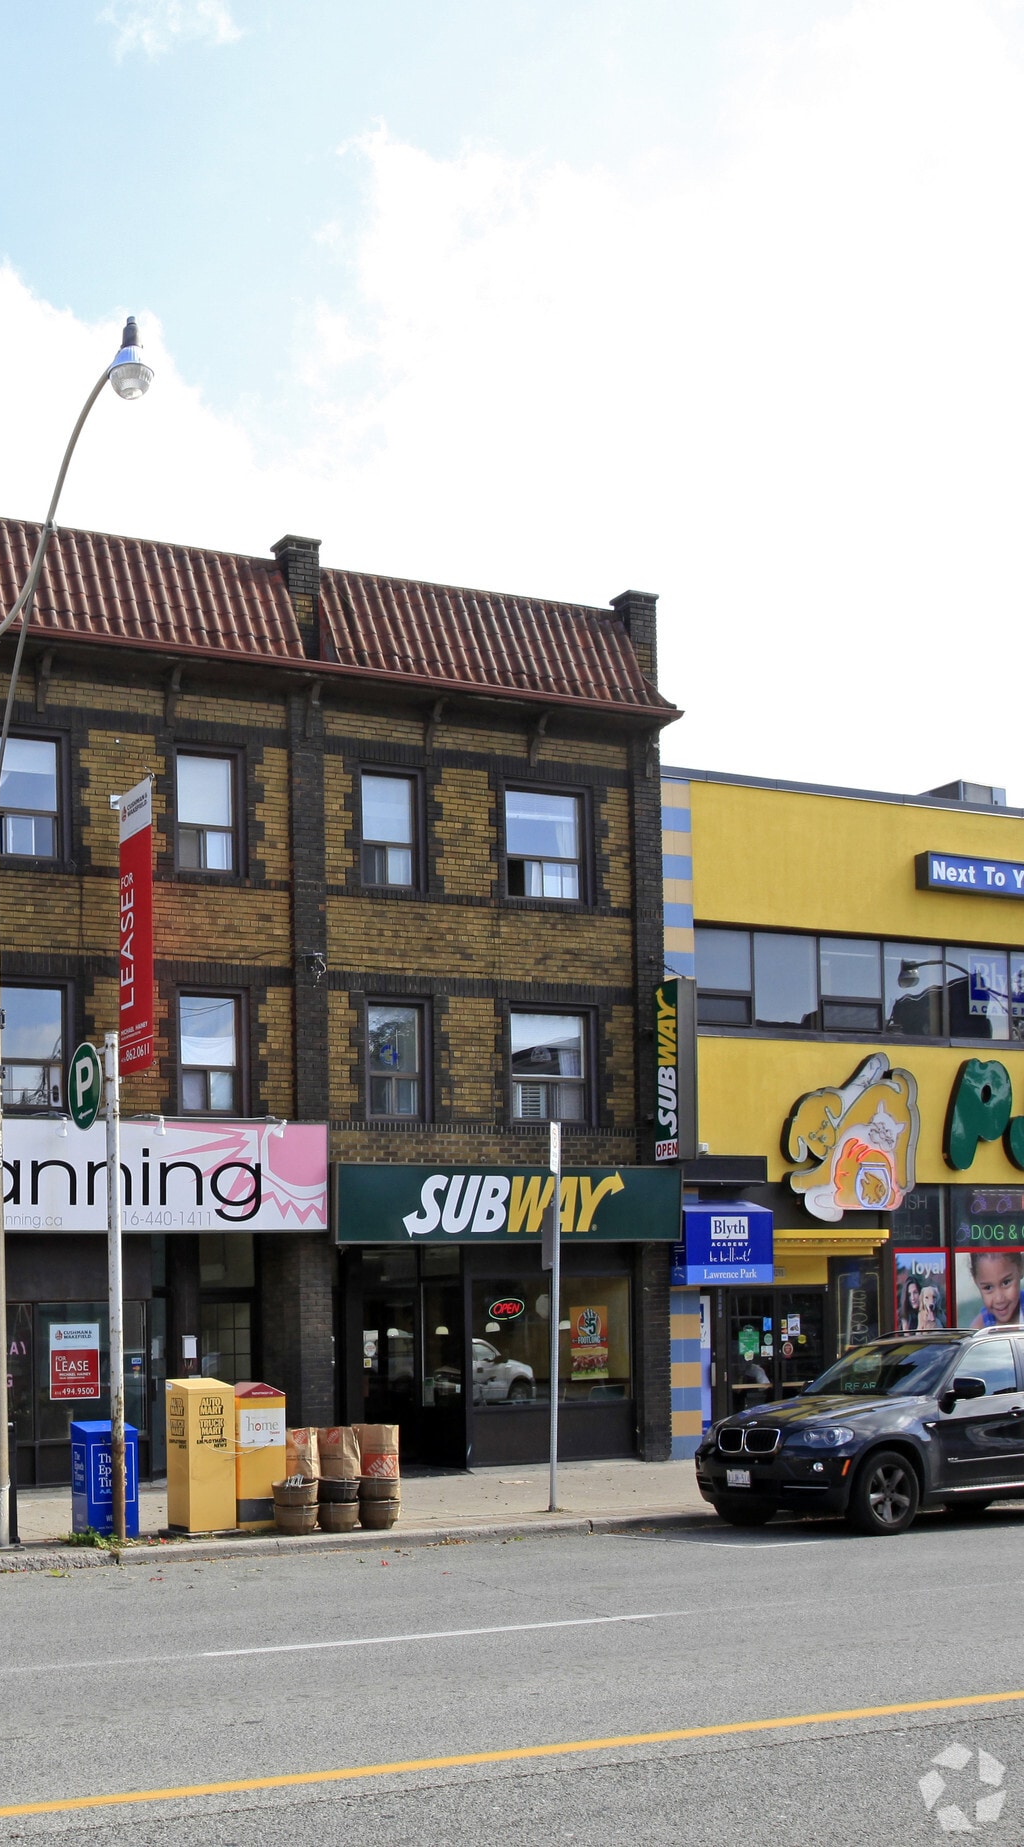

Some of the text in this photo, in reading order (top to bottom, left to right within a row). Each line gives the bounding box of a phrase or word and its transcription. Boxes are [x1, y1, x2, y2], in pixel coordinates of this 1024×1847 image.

[121, 872, 134, 889] FOR
[932, 860, 976, 884] Next
[983, 866, 1006, 887] To
[120, 888, 134, 1011] LEASE
[655, 987, 677, 1137] SUBWAY
[76, 1056, 94, 1108] P
[656, 1142, 677, 1157] OPEN
[402, 1171, 625, 1238] SUBWAY
[122, 1210, 213, 1227] 16-440-1411
[713, 1219, 746, 1239] Blyth
[971, 1224, 1018, 1241] DOG &
[703, 1268, 758, 1280] Lawrence Park
[912, 1258, 945, 1279] loyal
[493, 1302, 521, 1316] OPEN
[55, 1360, 89, 1372] LEASE
[62, 1387, 95, 1395] 494.9500
[200, 1397, 222, 1407] AUTO
[199, 1405, 224, 1416] MART
[199, 1418, 225, 1428] TRUCK
[246, 1416, 280, 1432] home
[200, 1426, 224, 1437] MART
